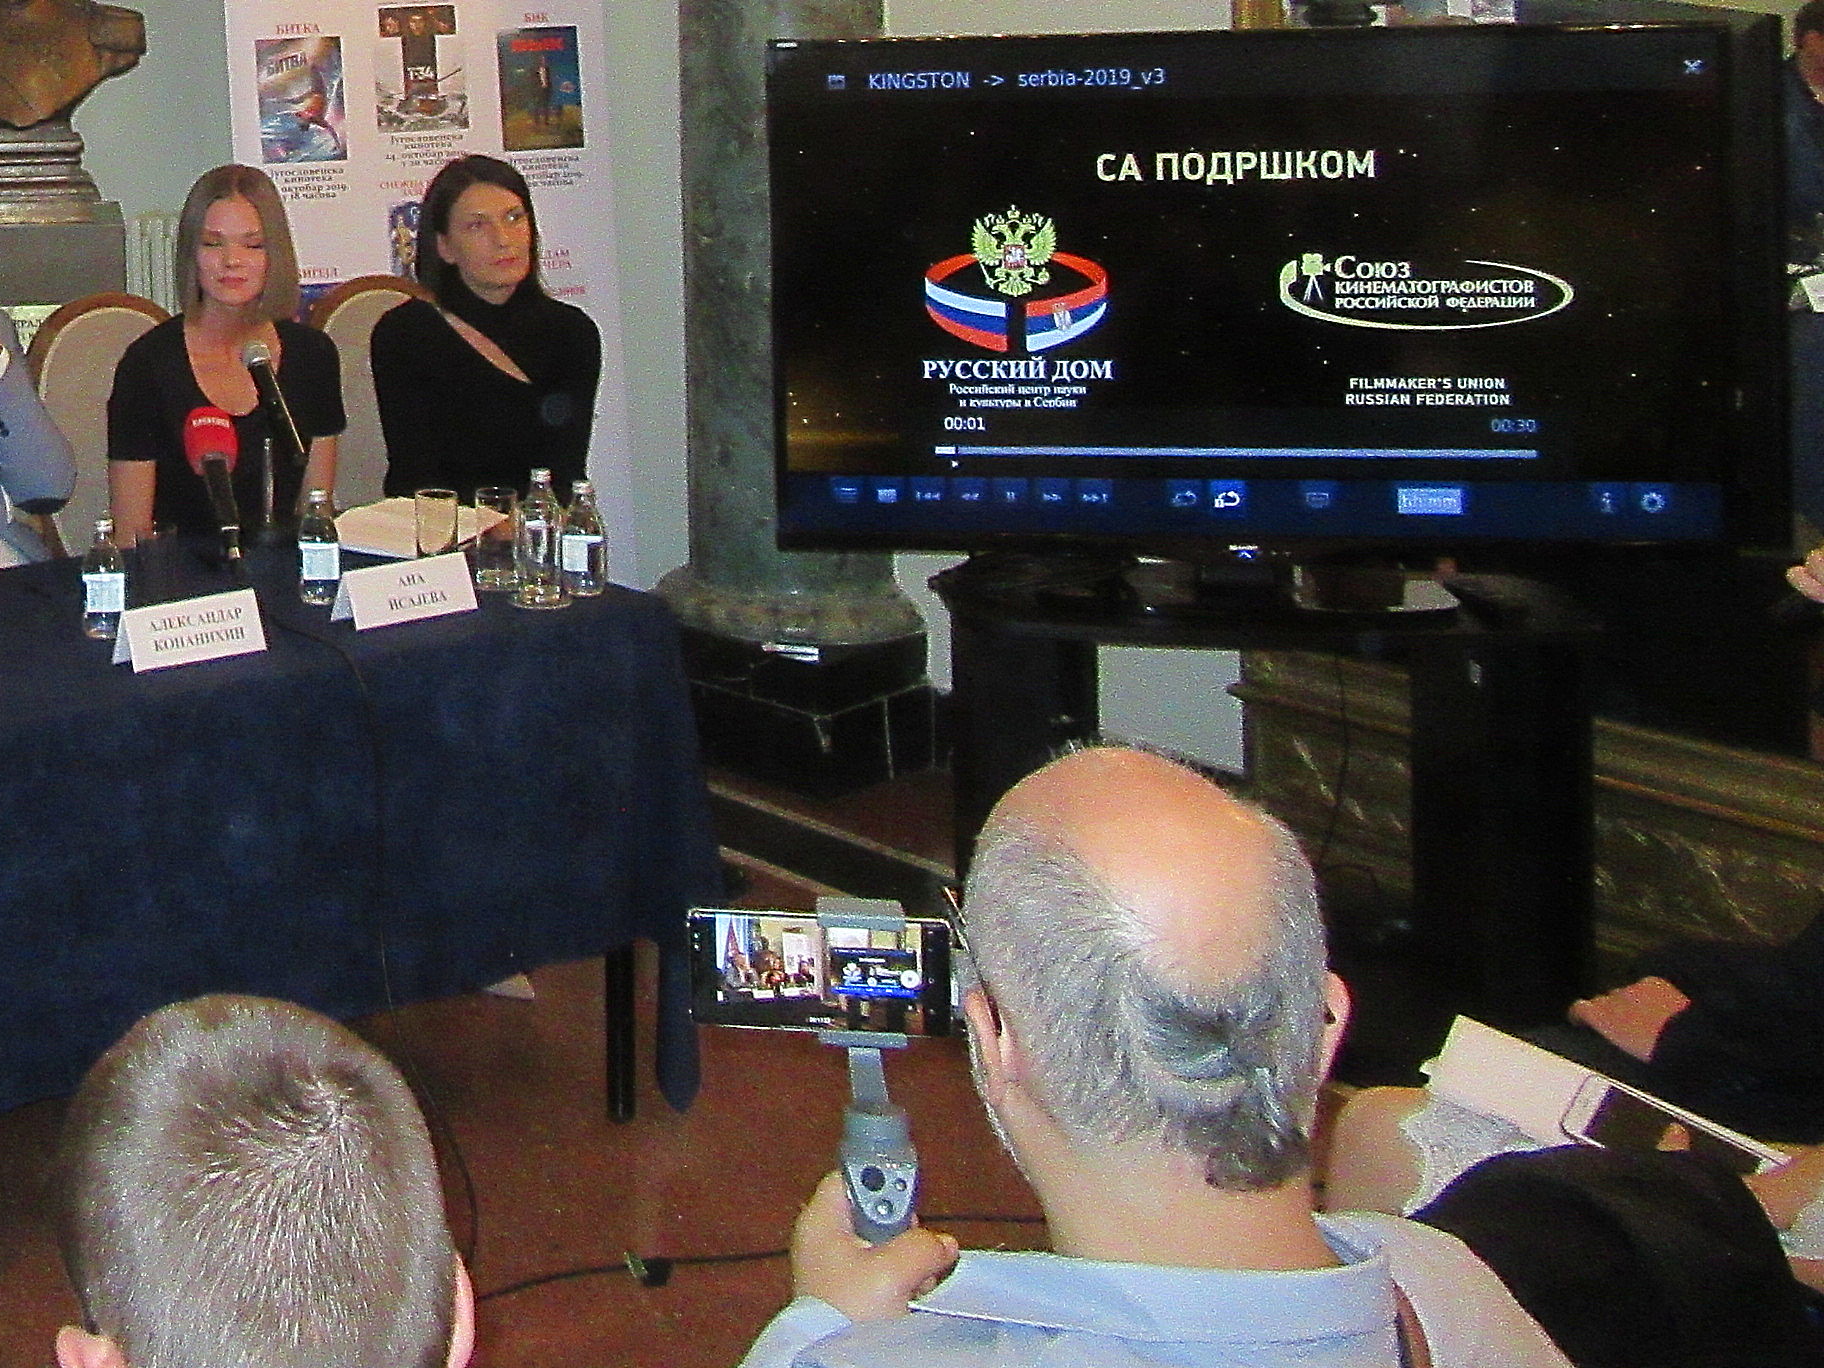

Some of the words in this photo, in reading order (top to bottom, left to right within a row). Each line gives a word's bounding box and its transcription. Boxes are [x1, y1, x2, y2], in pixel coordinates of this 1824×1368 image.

[276, 22, 321, 35] БИТКА
[868, 72, 970, 90] KINGSTON
[1017, 68, 1166, 90] serbia-2019_v3
[1096, 153, 1143, 182] СА
[1155, 149, 1375, 185] ПОДРШКОМ
[1334, 255, 1412, 280] Союз
[1334, 279, 1535, 295] КИНЕМАТОГРАФИСТОВ
[1334, 294, 1440, 310] РОССИЙСКОЙ
[1446, 295, 1536, 310] ФЕДЕРАЦИИ
[922, 356, 1047, 380] РУССКИЙ
[1051, 359, 1114, 383] ДОМ
[1349, 376, 1452, 391] FILMMAKER'S
[1457, 376, 1506, 390] UNION
[1345, 393, 1411, 407] RUSSIAN
[1416, 392, 1510, 407] FEDERATION
[944, 416, 986, 431] 00:01
[398, 573, 427, 588] АНА
[388, 590, 448, 611] ИСАЈЕВА
[149, 607, 242, 632] АЛЕКСАНДАР
